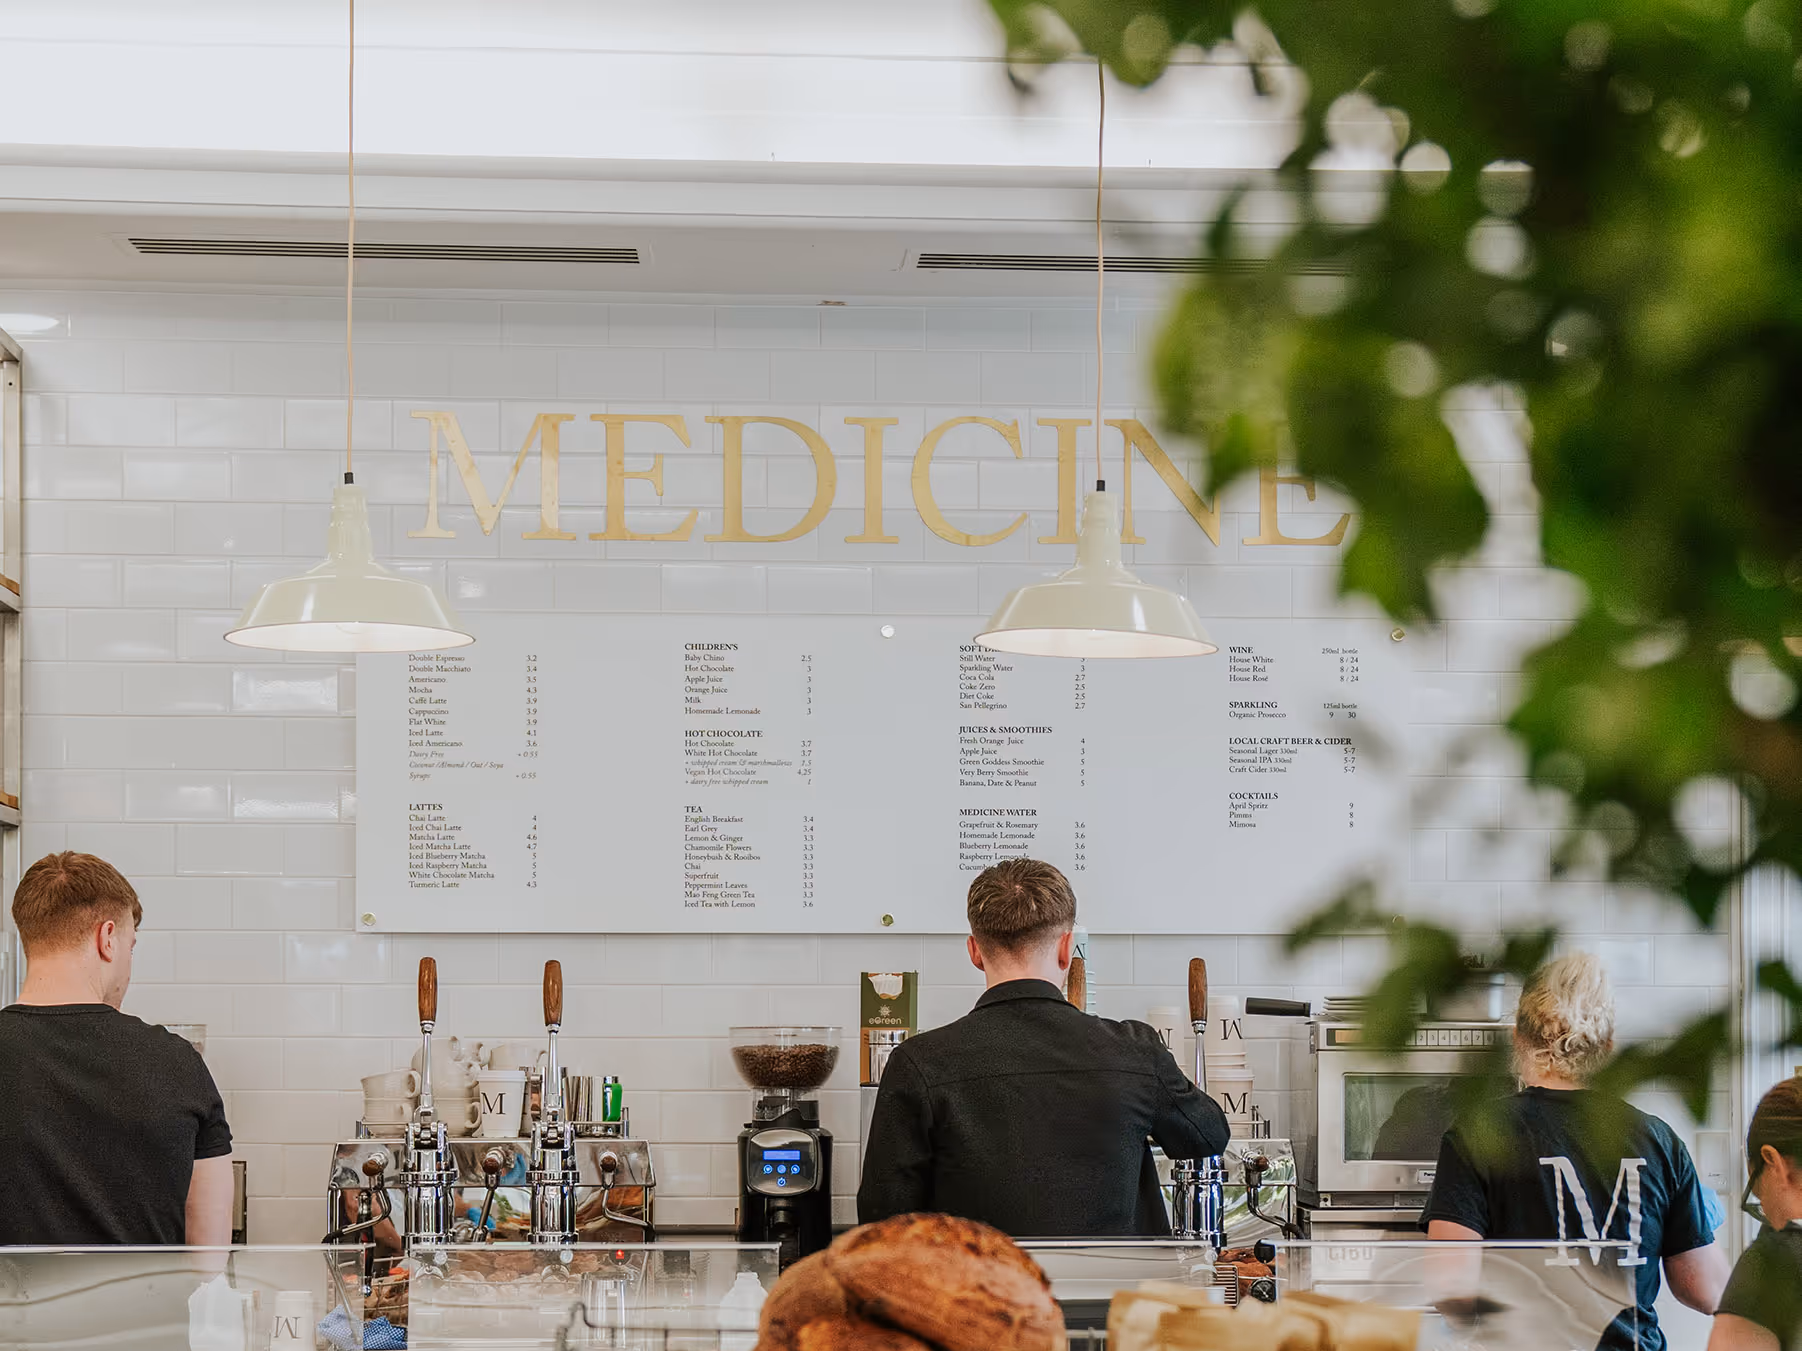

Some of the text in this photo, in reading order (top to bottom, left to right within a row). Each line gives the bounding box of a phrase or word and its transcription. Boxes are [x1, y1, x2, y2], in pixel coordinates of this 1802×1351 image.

[408, 410, 1350, 546] MEDICINE
[684, 643, 739, 651] CHILDREN'S
[1228, 646, 1254, 654] WINE
[408, 654, 465, 664] Double Espresso
[684, 654, 812, 664] Baby Chino 2.5
[960, 654, 995, 662] Still Water
[1229, 656, 1274, 664] House White
[959, 664, 1013, 674] Sparkling Water
[1229, 665, 1251, 673] House
[684, 675, 723, 685] Apple Juice
[408, 686, 433, 694] Mocha
[684, 686, 728, 696] Orange Juice
[684, 696, 702, 704] Milk
[959, 692, 994, 700] Diet Coke
[429, 697, 447, 705] Latte
[684, 707, 761, 715] Homemade Lemonade
[974, 702, 1008, 711] Pellegrino
[408, 708, 449, 717] Cappuccino
[1228, 711, 1256, 720] Organic
[1348, 711, 1357, 719] 30
[423, 718, 446, 726] White
[408, 729, 443, 737] Iced Latte
[684, 730, 763, 738] HOT CHOCOLATE
[958, 726, 1053, 736] JUICES SMOOTHIES
[979, 737, 1005, 746] Orange
[1007, 737, 1024, 746] Juice
[684, 749, 758, 757] White Chocolate
[959, 748, 998, 757] Apple Juice
[1259, 747, 1278, 756] Lager
[959, 758, 1045, 766] Green Goddess Smoothie
[1229, 756, 1273, 764] Seasonal IPA
[685, 768, 757, 778] Vegan Chocolate
[959, 769, 976, 778] Very
[976, 769, 996, 778] Berry
[959, 779, 1037, 789] Banana, Date Peanut
[1228, 792, 1279, 800] COCKTAILS
[409, 803, 443, 811] LATTES
[684, 806, 703, 814] TEA
[1228, 802, 1268, 812] April Spritz
[959, 808, 1037, 817] MEDICINE WATER
[1229, 811, 1253, 819] Pimms
[408, 814, 446, 822] Chai Latte
[684, 815, 711, 825] English
[712, 815, 744, 823] Breakfast
[700, 825, 718, 834] Grey
[958, 821, 1039, 831] Grapefruit Rosemary
[409, 833, 435, 841] Matcha
[437, 833, 455, 841] Latte
[684, 834, 743, 844] Lemon Ginger
[1074, 832, 1086, 840] 3.6
[959, 842, 1029, 852] Blueberry Lemonade
[409, 852, 486, 862] Iced Blueberry Matcha
[684, 853, 761, 863] Honeybush Rooibos
[960, 853, 993, 862] Raspberry
[425, 862, 459, 871] Raspberry
[408, 871, 495, 879] White Chocolate Matcha
[684, 872, 719, 882] Superfruit
[684, 882, 723, 891] Peppermint
[702, 891, 742, 901] Feng Green
[481, 1092, 506, 1115] M
[1221, 1092, 1248, 1114] M
[1538, 1156, 1648, 1266] M
